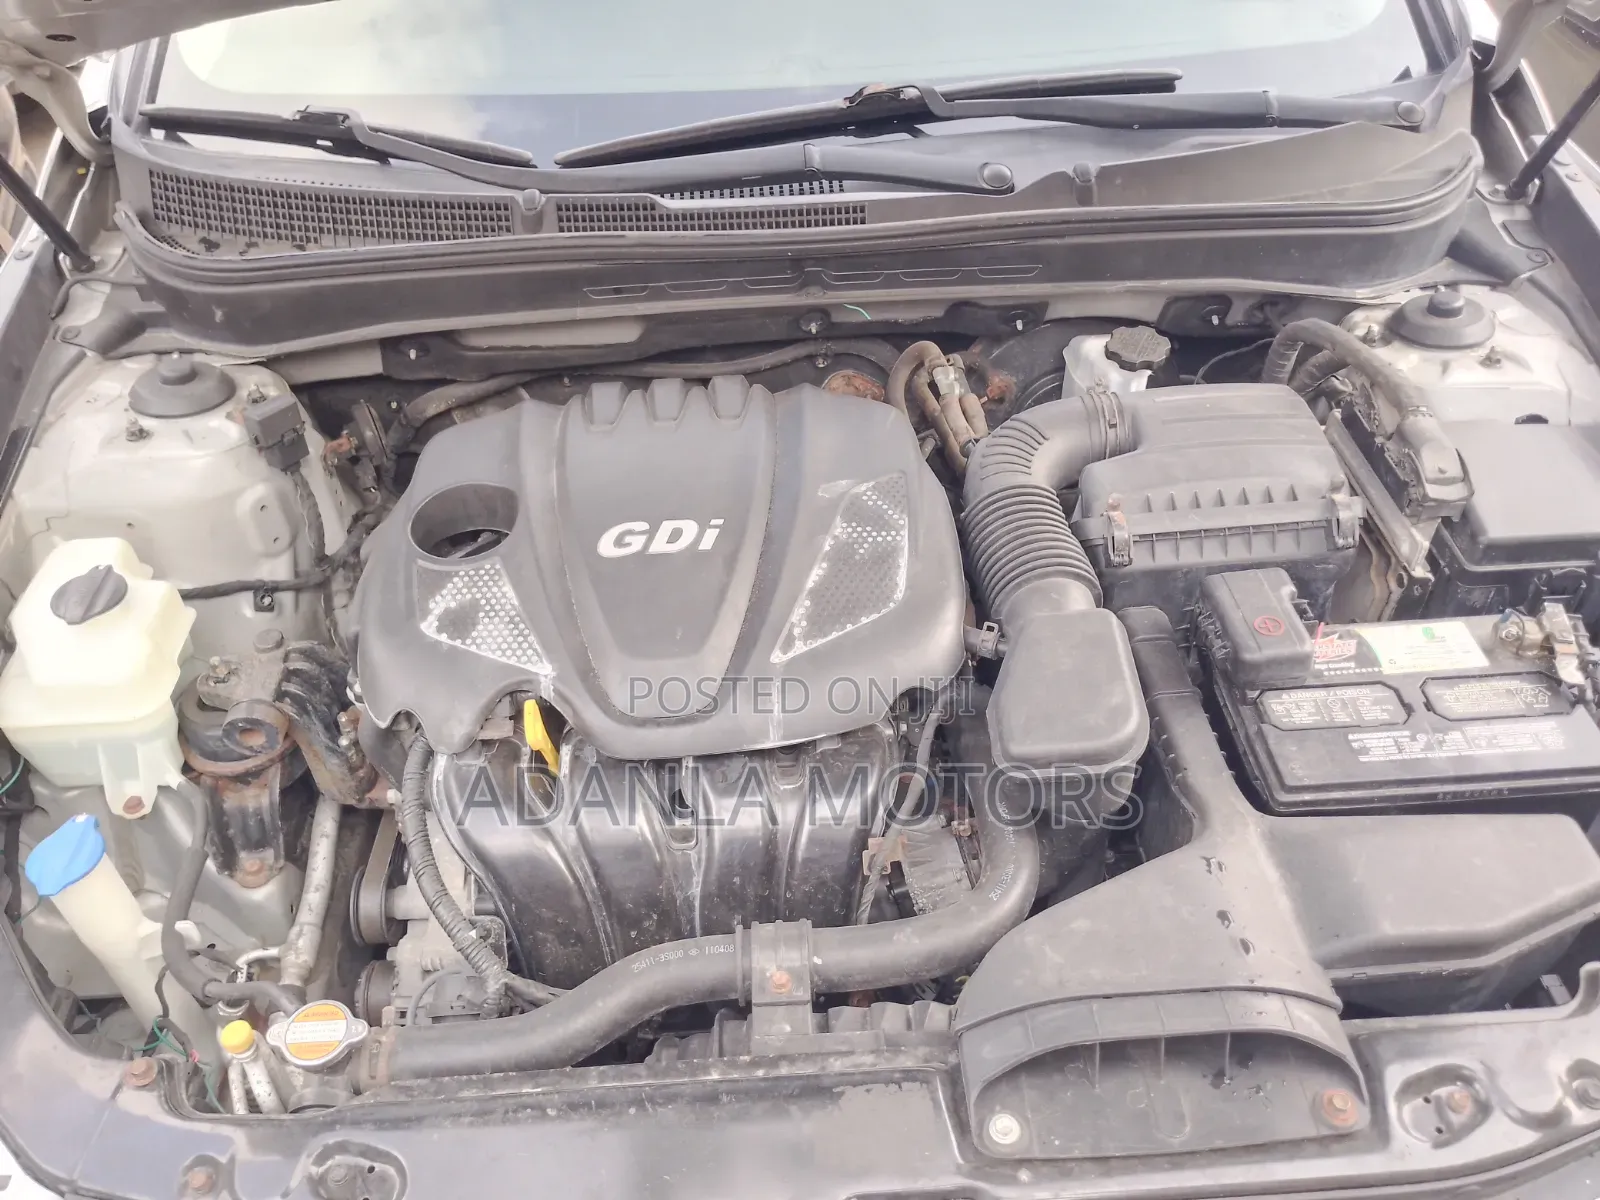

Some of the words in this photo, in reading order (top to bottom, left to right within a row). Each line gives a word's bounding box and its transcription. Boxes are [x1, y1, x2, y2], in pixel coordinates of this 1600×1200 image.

[597, 519, 725, 558] GDi
[1290, 690, 1328, 699] DANGER
[1336, 688, 1371, 697] POISON
[632, 949, 684, 973] 25411-3S000
[705, 944, 735, 956] 110408
